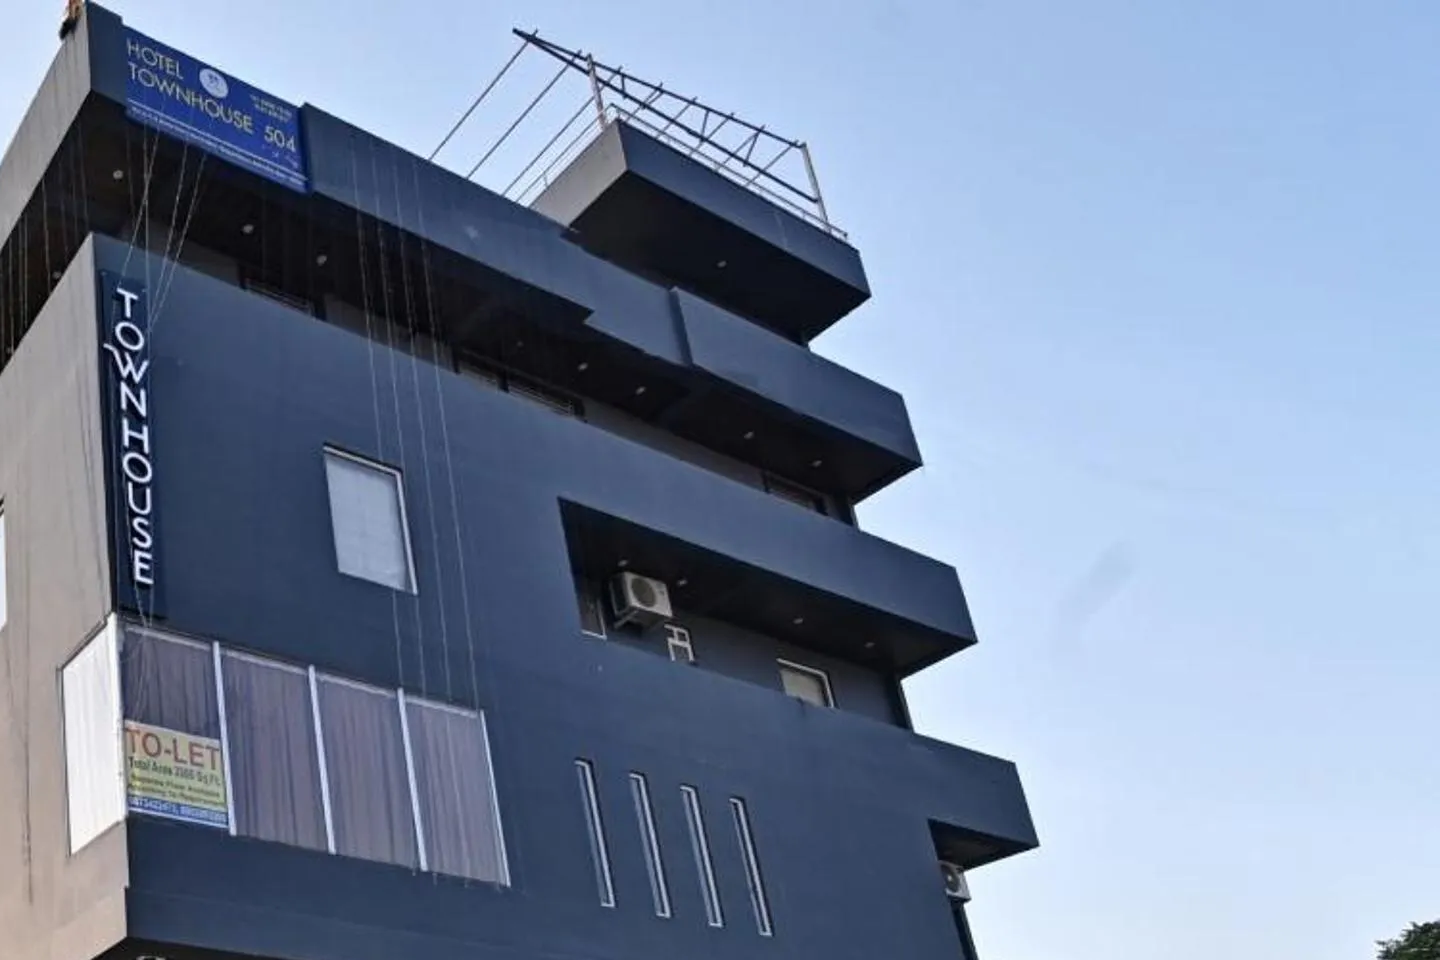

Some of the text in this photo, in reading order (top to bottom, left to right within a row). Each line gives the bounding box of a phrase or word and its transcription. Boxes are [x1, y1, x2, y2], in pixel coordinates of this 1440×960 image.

[126, 37, 184, 80] HOTEL
[127, 61, 254, 135] TOWNHOUSE
[264, 125, 296, 153] 504
[103, 286, 154, 586] TOWNHOUSE
[123, 727, 220, 771] TO-LET
